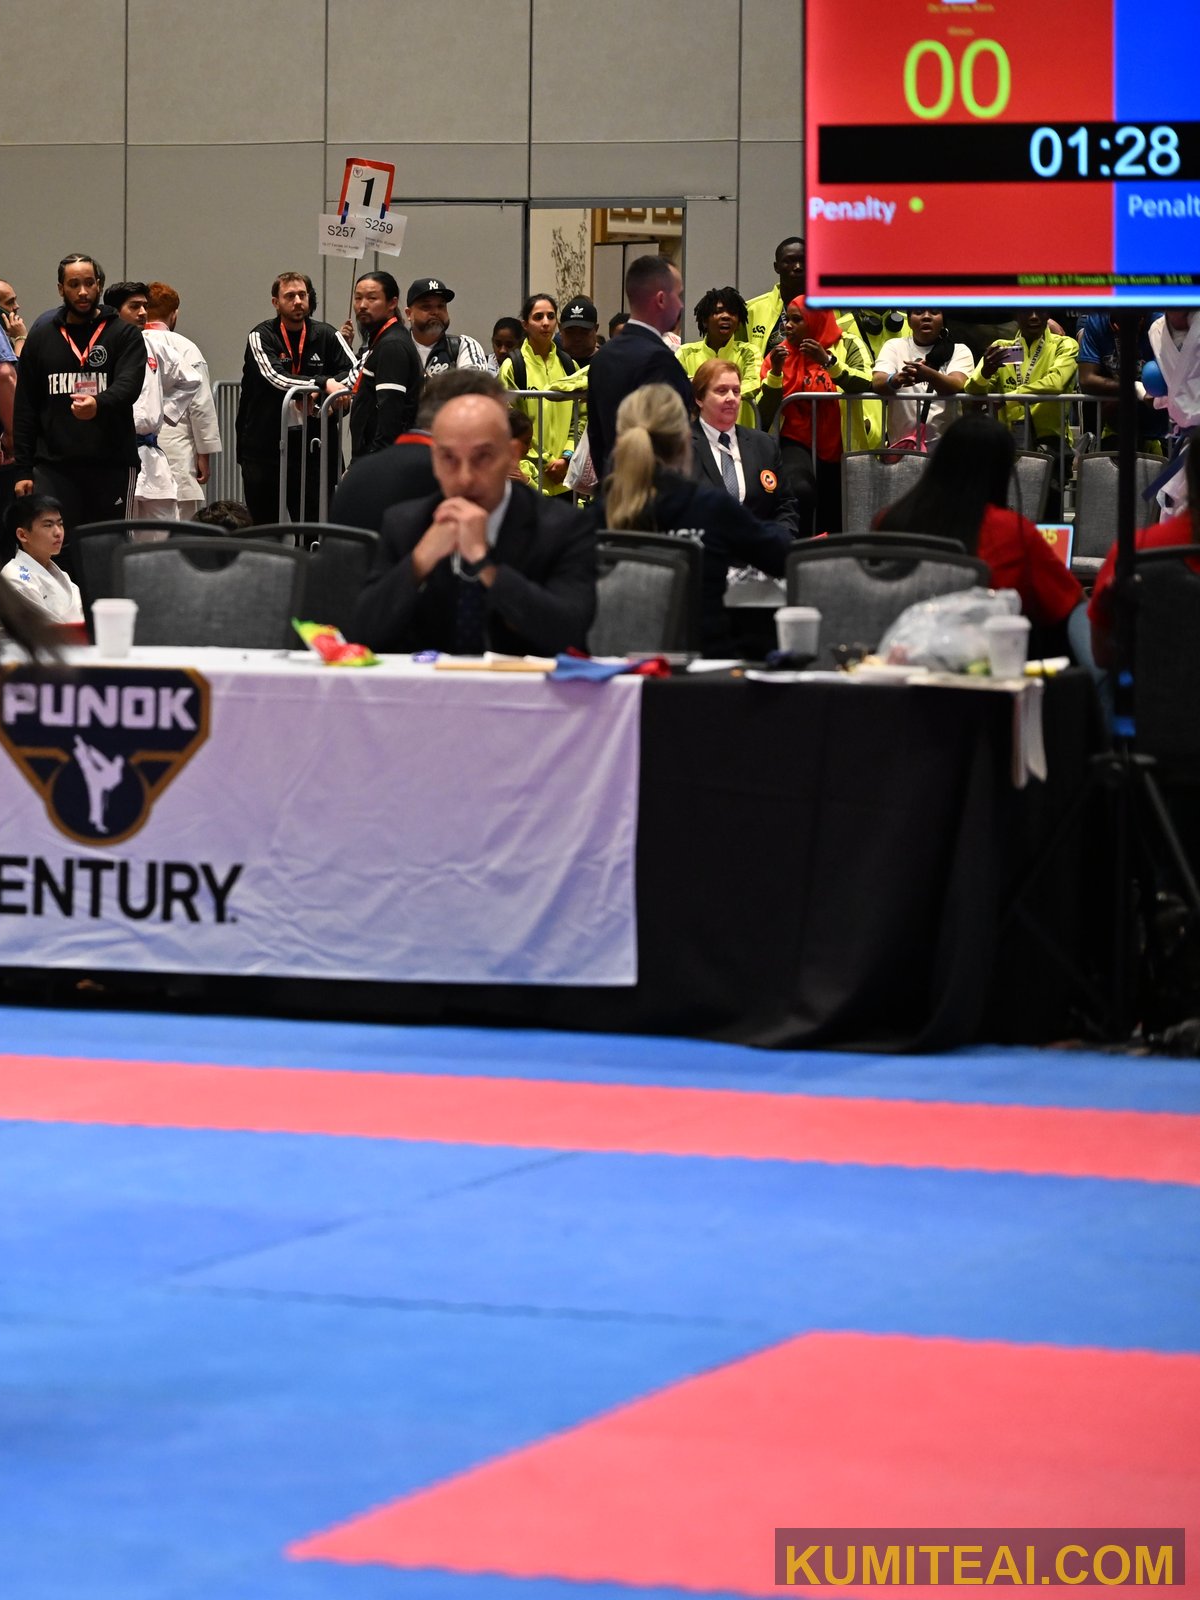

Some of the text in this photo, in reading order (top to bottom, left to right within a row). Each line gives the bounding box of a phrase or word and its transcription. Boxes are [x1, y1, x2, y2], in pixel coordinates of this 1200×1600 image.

[904, 38, 1011, 120] 00
[1029, 125, 1181, 178] 01:28
[360, 177, 375, 207] 1
[809, 194, 896, 225] Penalty
[327, 224, 356, 238] S257
[365, 217, 393, 234] S259
[2, 683, 197, 731] PUNOK
